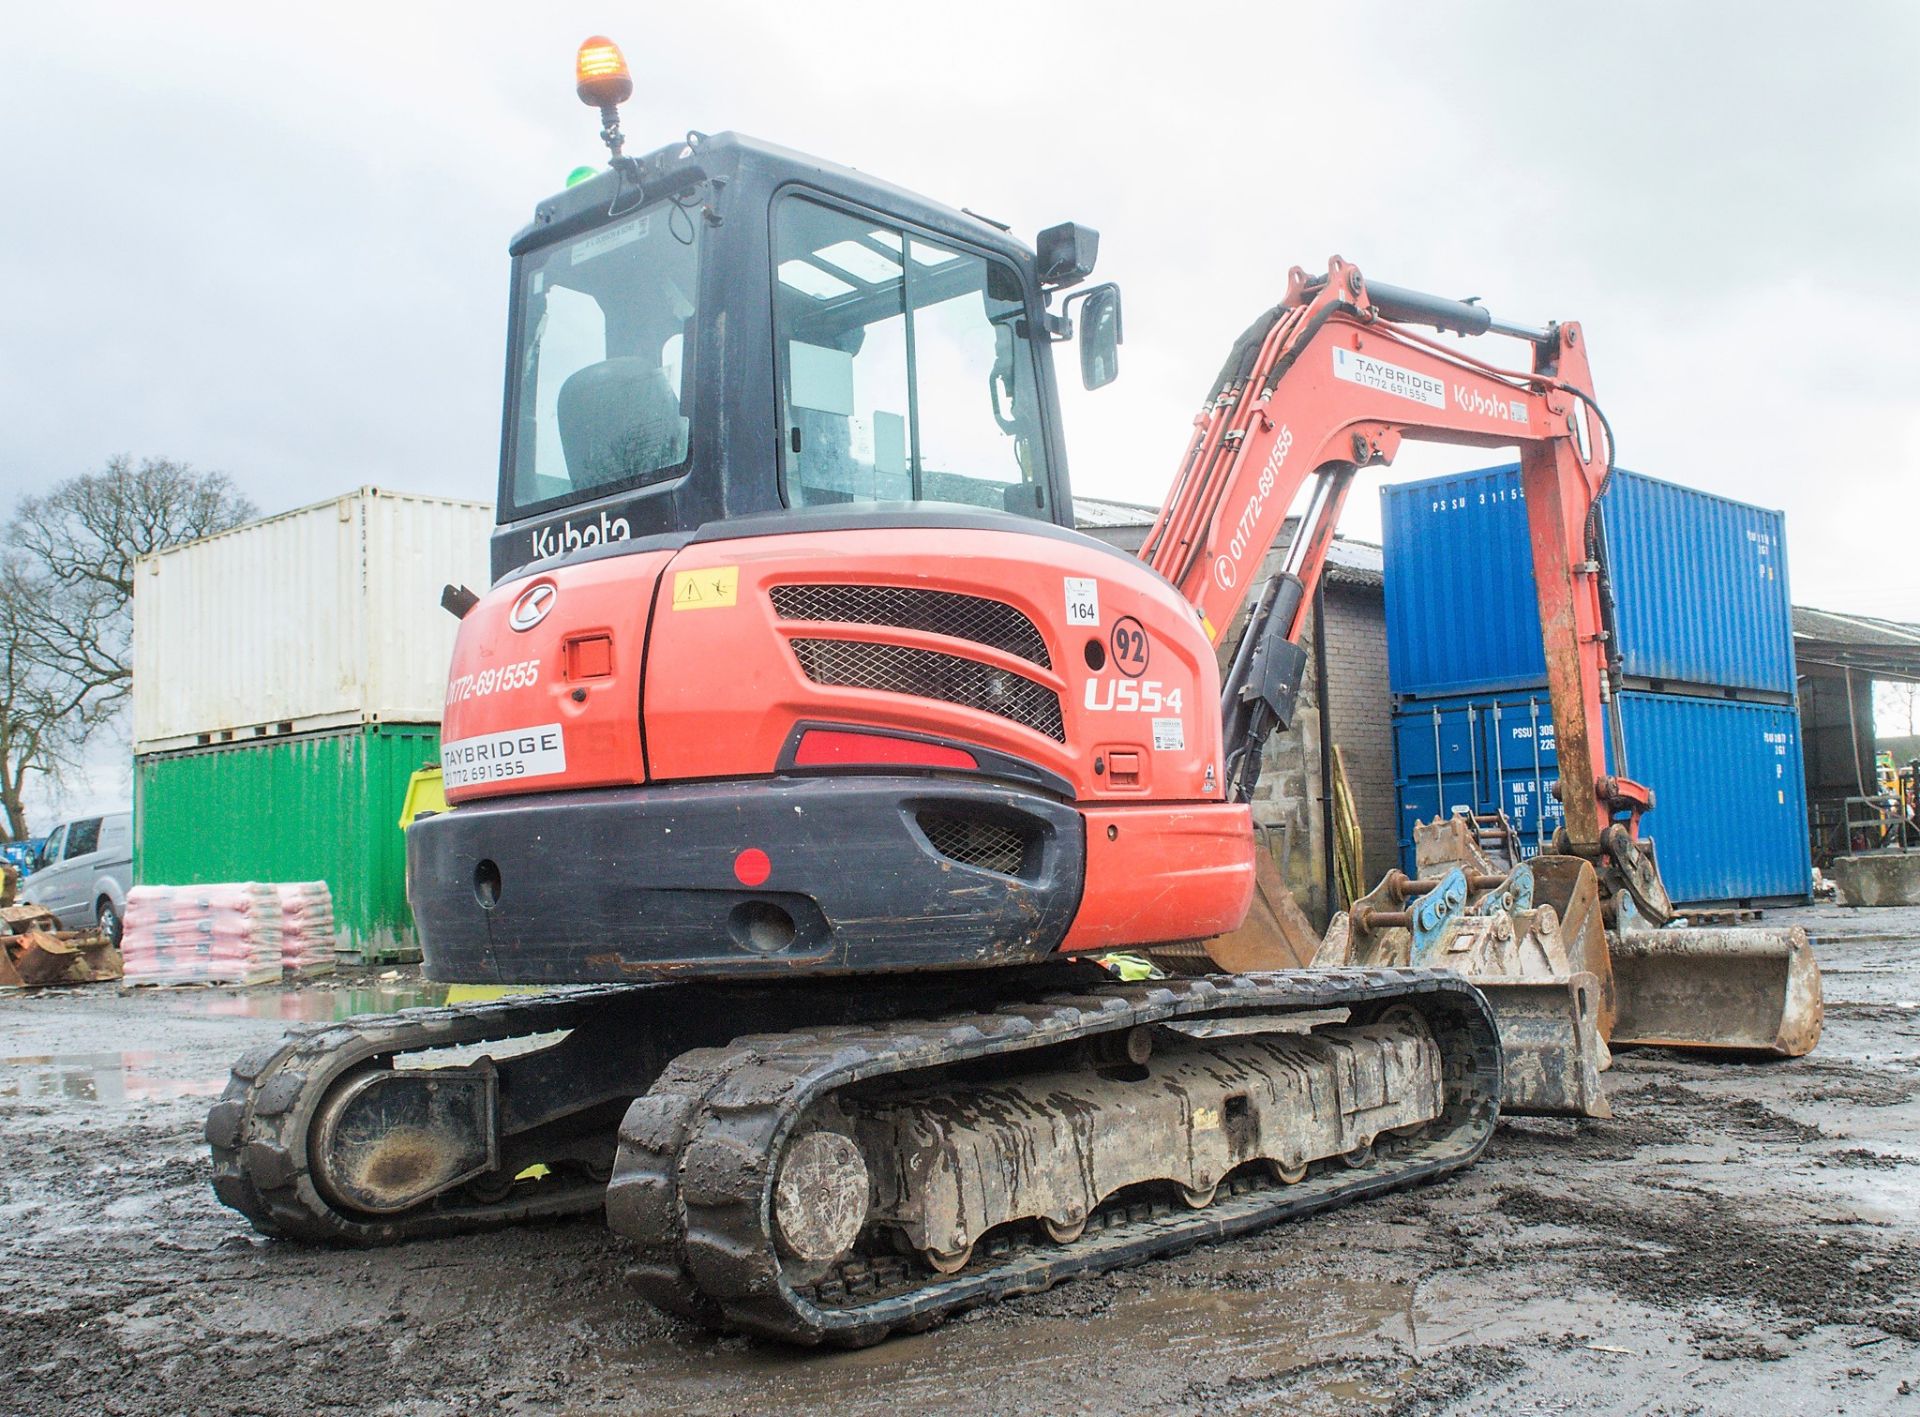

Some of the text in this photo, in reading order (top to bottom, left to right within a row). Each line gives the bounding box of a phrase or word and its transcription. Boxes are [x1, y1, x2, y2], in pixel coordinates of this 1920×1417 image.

[1355, 371, 1427, 402] 01772 691555
[1356, 358, 1443, 395] TAYBRIDGE
[1454, 384, 1509, 420] Kubota
[1230, 424, 1293, 560] 01772-691555
[532, 511, 631, 559] Kubota
[1071, 602, 1095, 619] 164
[1116, 627, 1145, 663] 92
[1513, 727, 1532, 738] PSSU
[445, 733, 558, 767] TAYBRIDGE
[471, 760, 525, 781] 691555
[1514, 794, 1528, 805] TARE
[1514, 806, 1525, 817] NET
